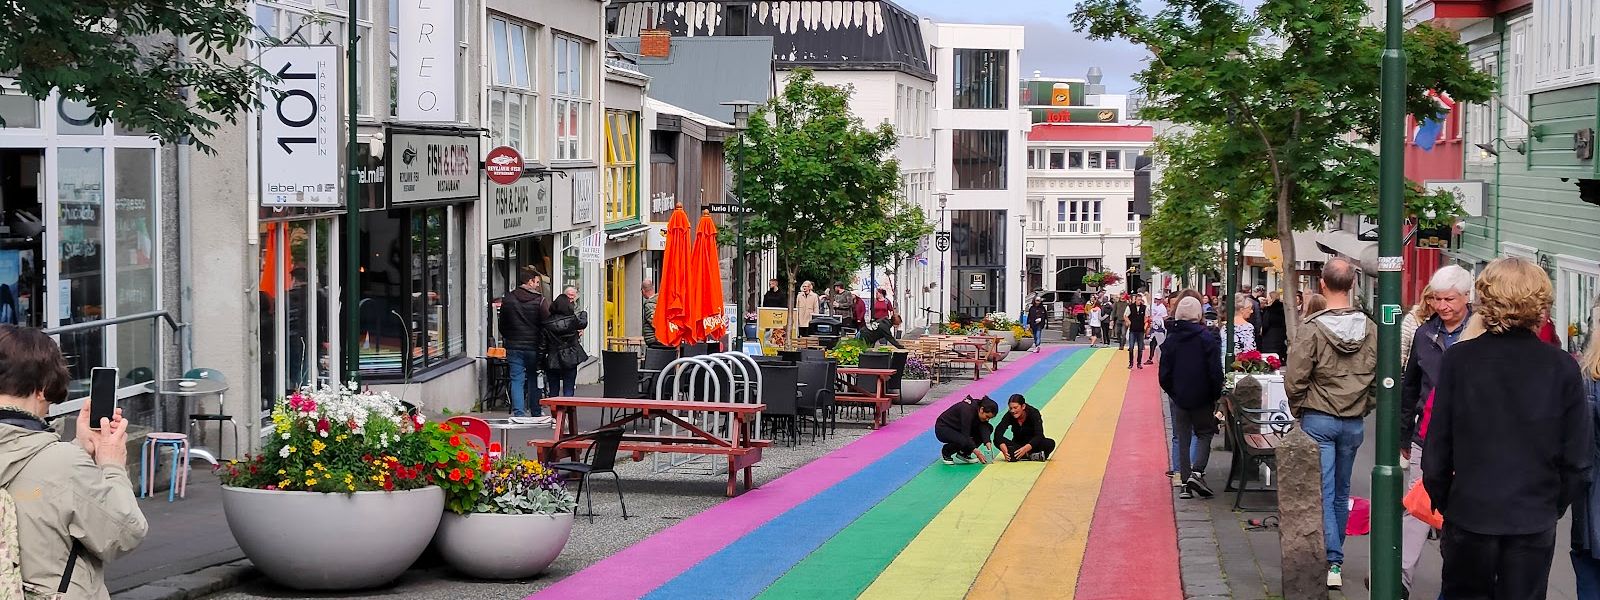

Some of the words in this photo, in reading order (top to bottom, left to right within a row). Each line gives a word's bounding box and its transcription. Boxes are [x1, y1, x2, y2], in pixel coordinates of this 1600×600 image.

[276, 61, 317, 155] 101
[427, 143, 443, 176] FISH
[443, 146, 450, 175] &
[495, 187, 508, 216] FISH
[508, 188, 514, 215] &
